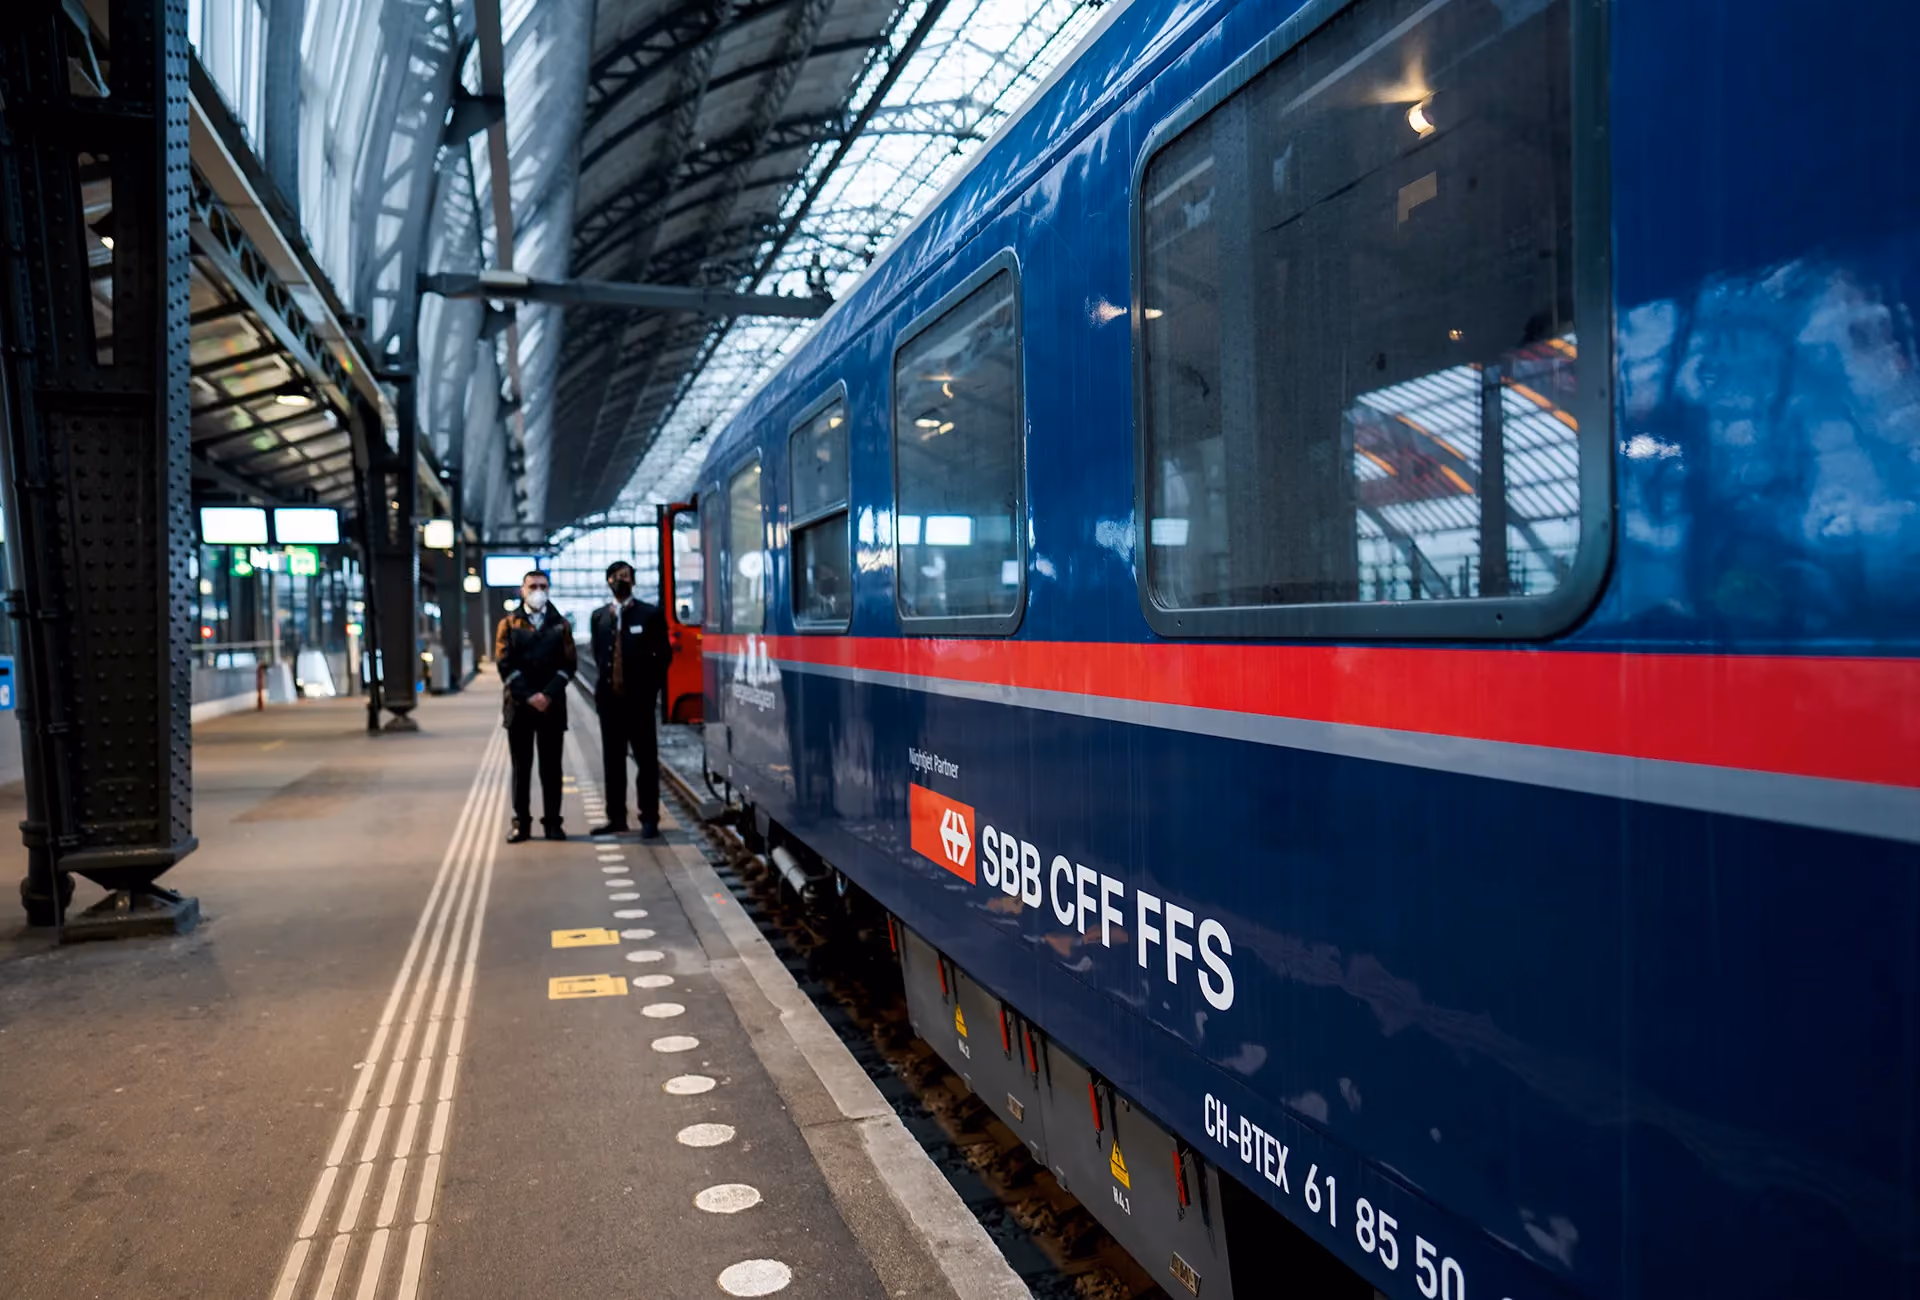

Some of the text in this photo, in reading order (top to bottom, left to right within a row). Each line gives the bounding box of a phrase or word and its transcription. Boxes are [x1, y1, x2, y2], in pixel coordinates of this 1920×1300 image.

[908, 747, 959, 779] Nightjet Partner
[982, 824, 1235, 1011] SBB CFF FFS
[1204, 1092, 1290, 1195] CH-BTEX
[1304, 1163, 1337, 1228] 61
[1355, 1197, 1399, 1271] 85
[1415, 1235, 1465, 1300] 50
